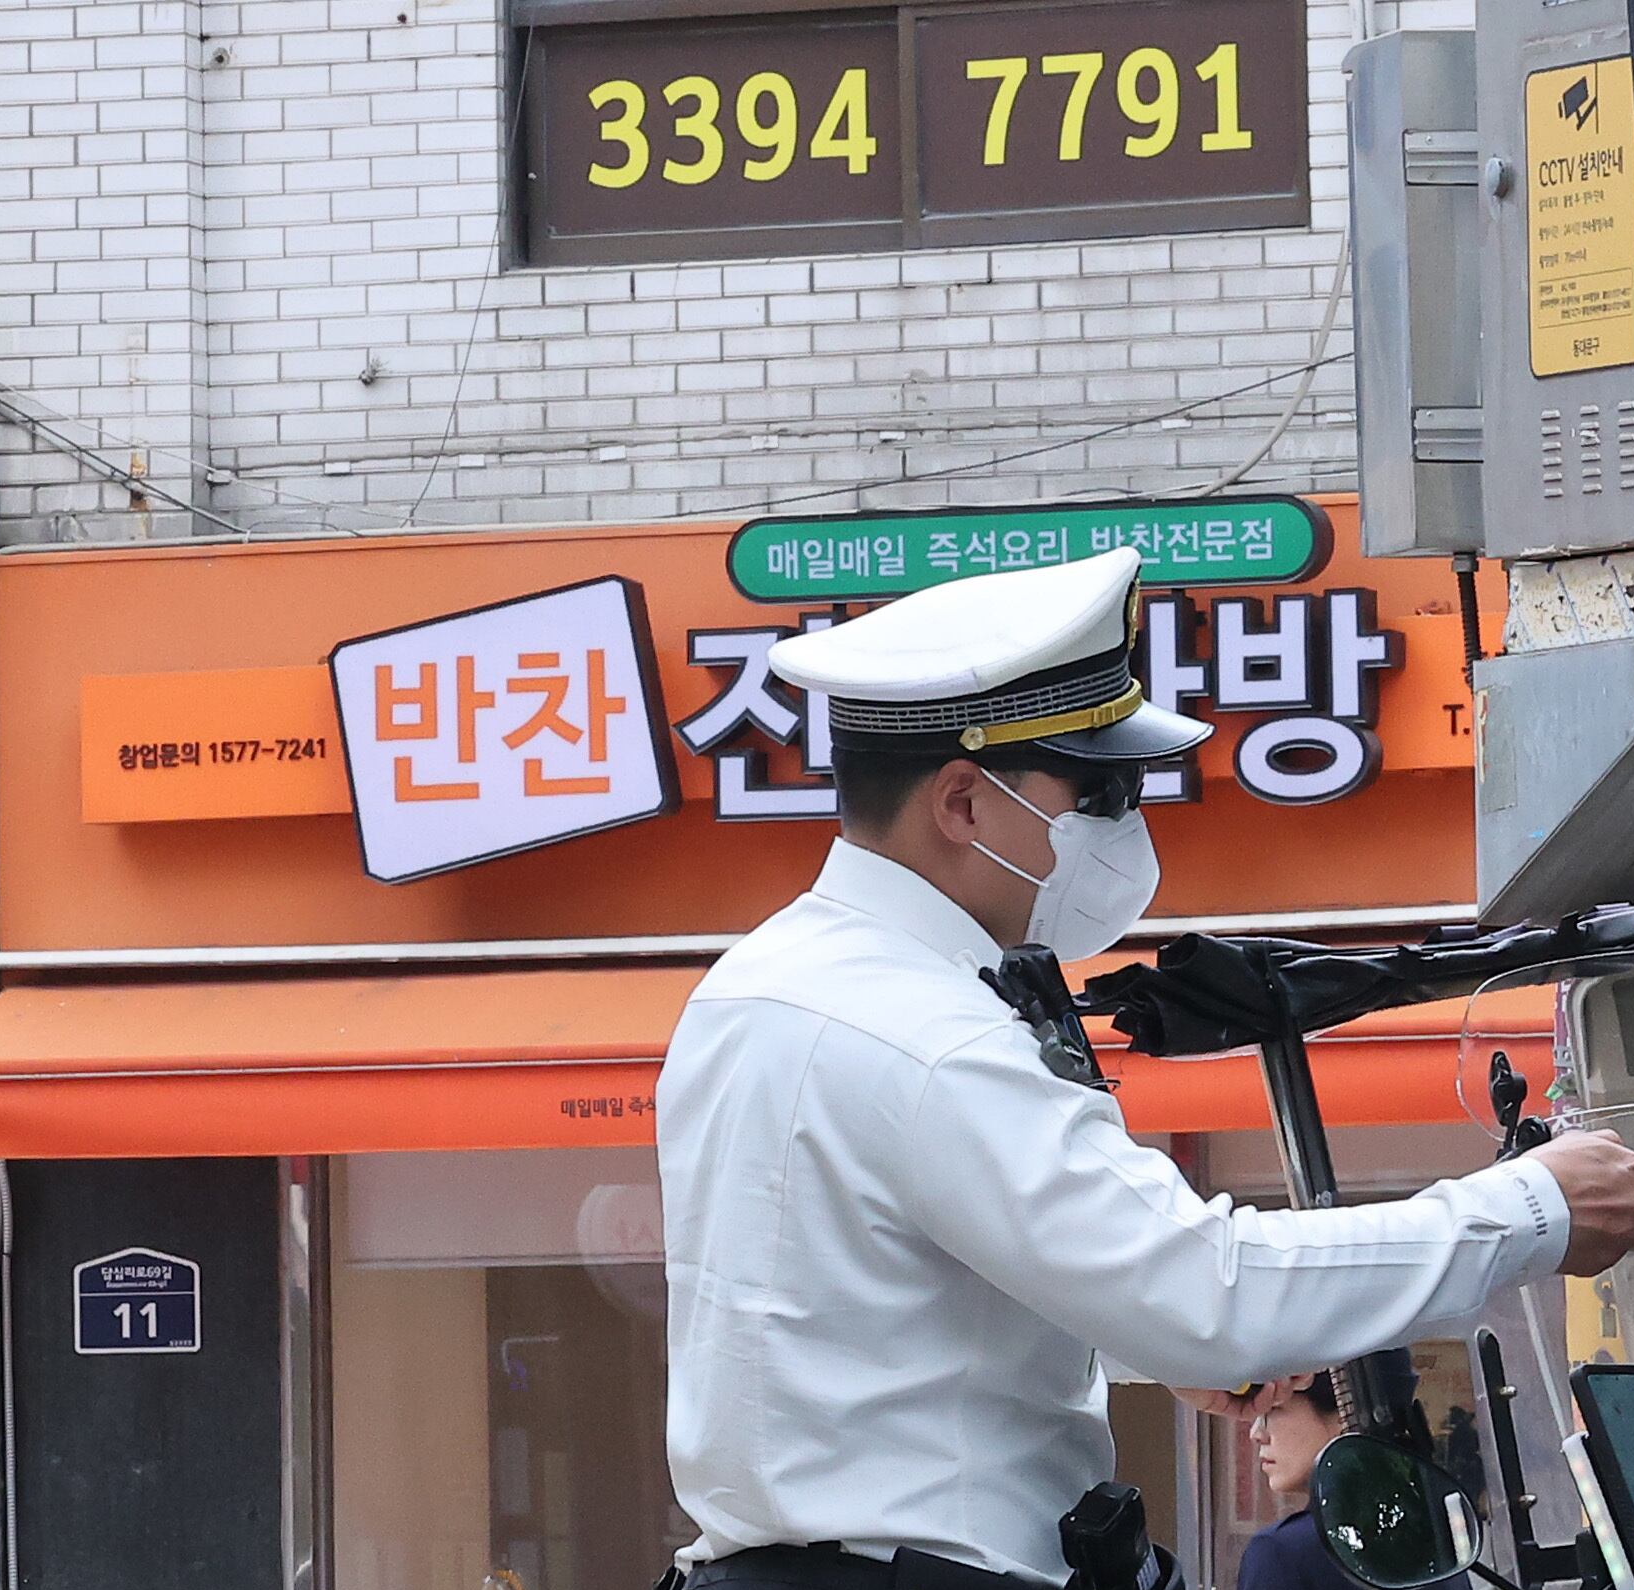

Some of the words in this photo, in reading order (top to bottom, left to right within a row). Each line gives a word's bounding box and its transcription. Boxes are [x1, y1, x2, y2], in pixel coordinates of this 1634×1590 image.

[587, 69, 876, 189] 3394
[966, 43, 1253, 167] 7791
[1539, 156, 1575, 187] CCTV
[1577, 145, 1623, 181] 설치안내
[767, 535, 905, 580] 매일매일
[926, 527, 1068, 573] 즉석요리
[1091, 517, 1274, 567] 반찬전문점
[374, 648, 626, 803] 반찬
[671, 587, 1389, 822] 진방
[118, 742, 202, 770] 창업문의
[207, 737, 327, 765] 1577-7241
[560, 1097, 623, 1118] 매일매일
[101, 1266, 172, 1281] 답십리로69길
[113, 1302, 157, 1338] 11
